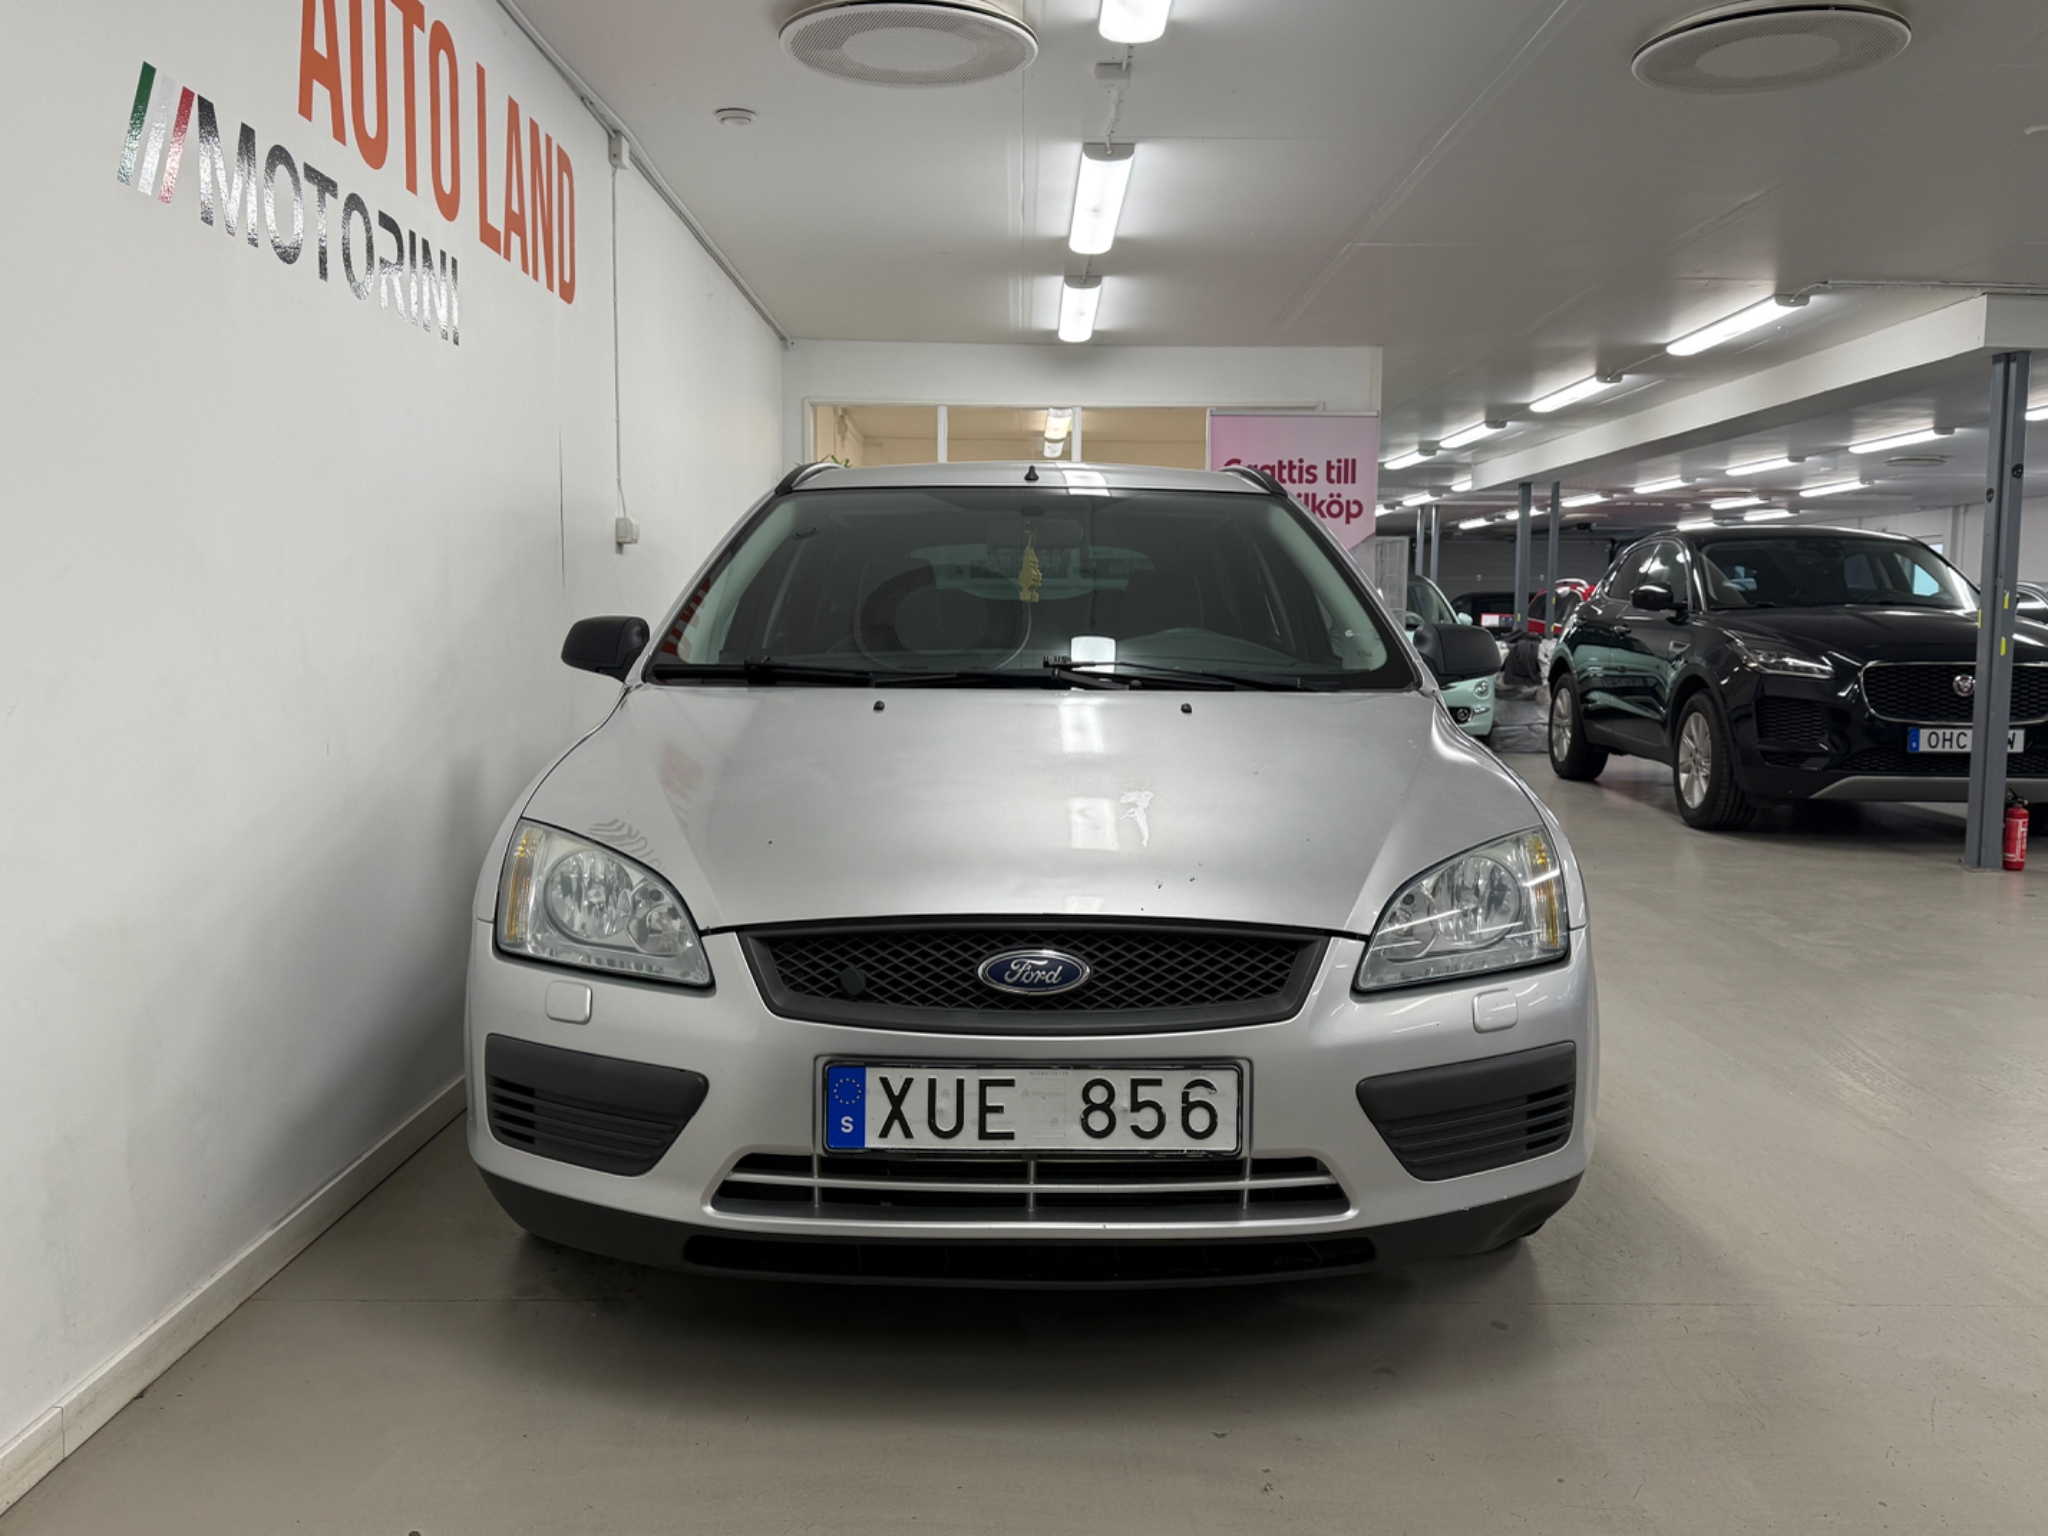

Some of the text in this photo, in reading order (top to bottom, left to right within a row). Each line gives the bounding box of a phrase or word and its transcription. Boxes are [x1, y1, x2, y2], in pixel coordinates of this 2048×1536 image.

[298, 0, 575, 305] AUTO LAND
[197, 94, 460, 346] MOTORINI
[1326, 458, 1356, 484] till
[1928, 731, 1968, 750] OHC
[1004, 958, 1063, 984] Ford
[841, 1077, 1218, 1141] S XUE 856
